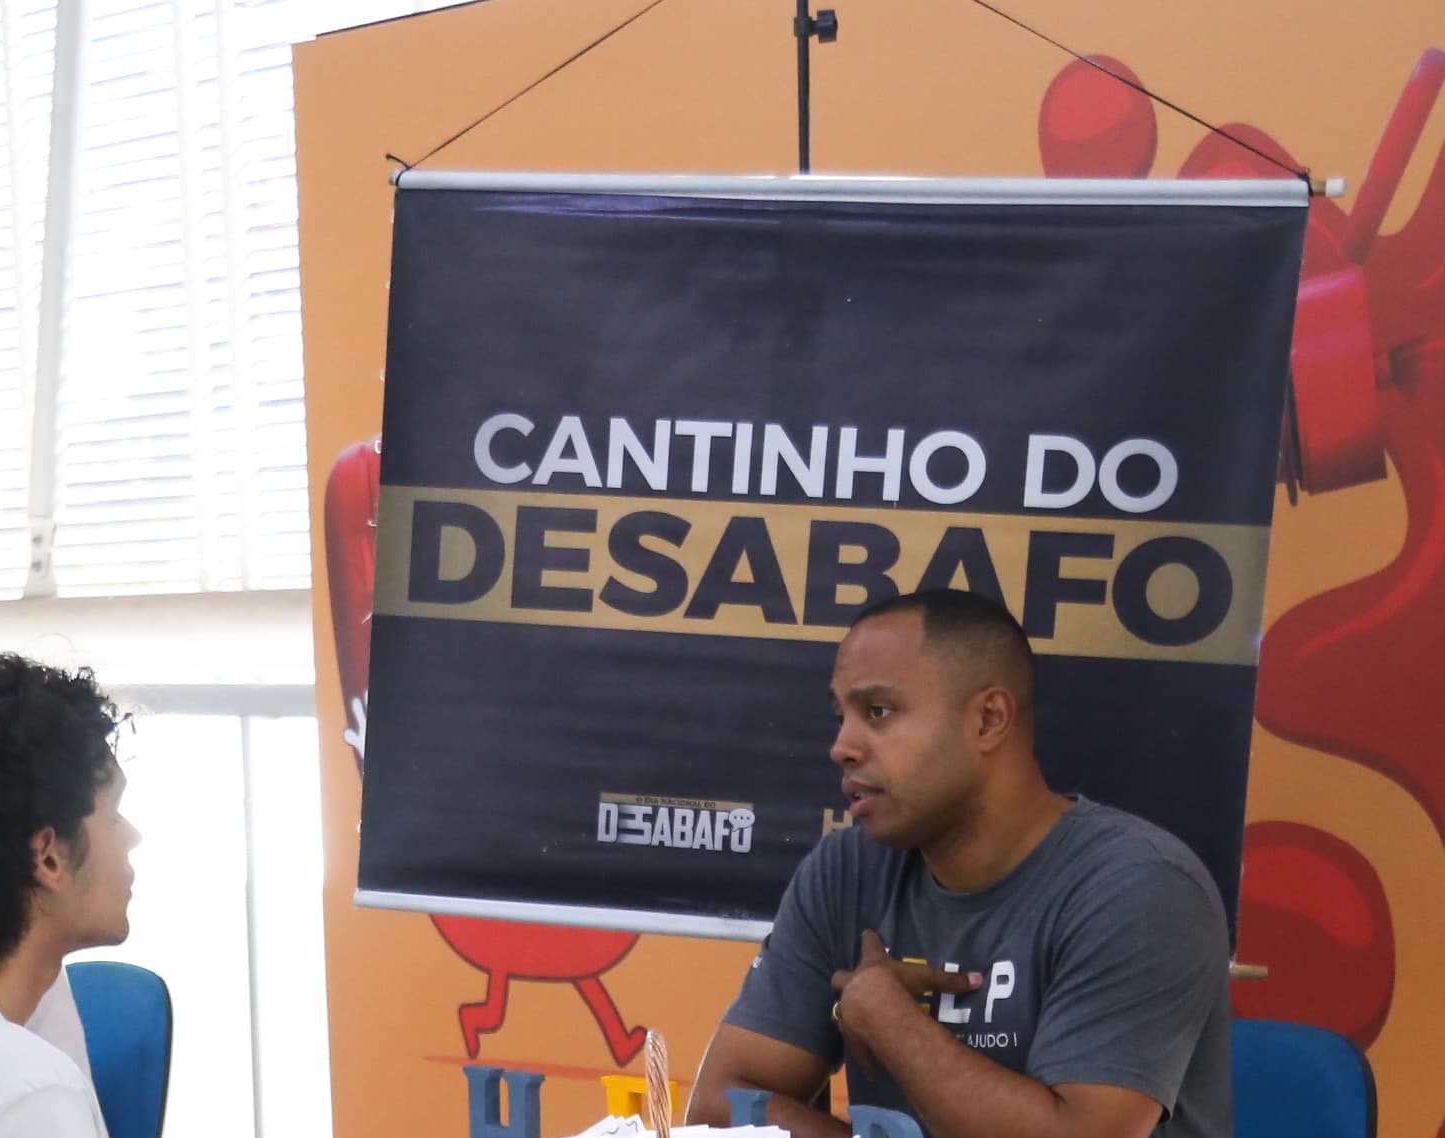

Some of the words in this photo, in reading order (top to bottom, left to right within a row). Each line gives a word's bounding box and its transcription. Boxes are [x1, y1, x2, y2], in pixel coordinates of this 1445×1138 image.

[473, 412, 987, 505] CANTINHO
[1023, 433, 1179, 513] DO
[406, 499, 1234, 647] DESABAFO
